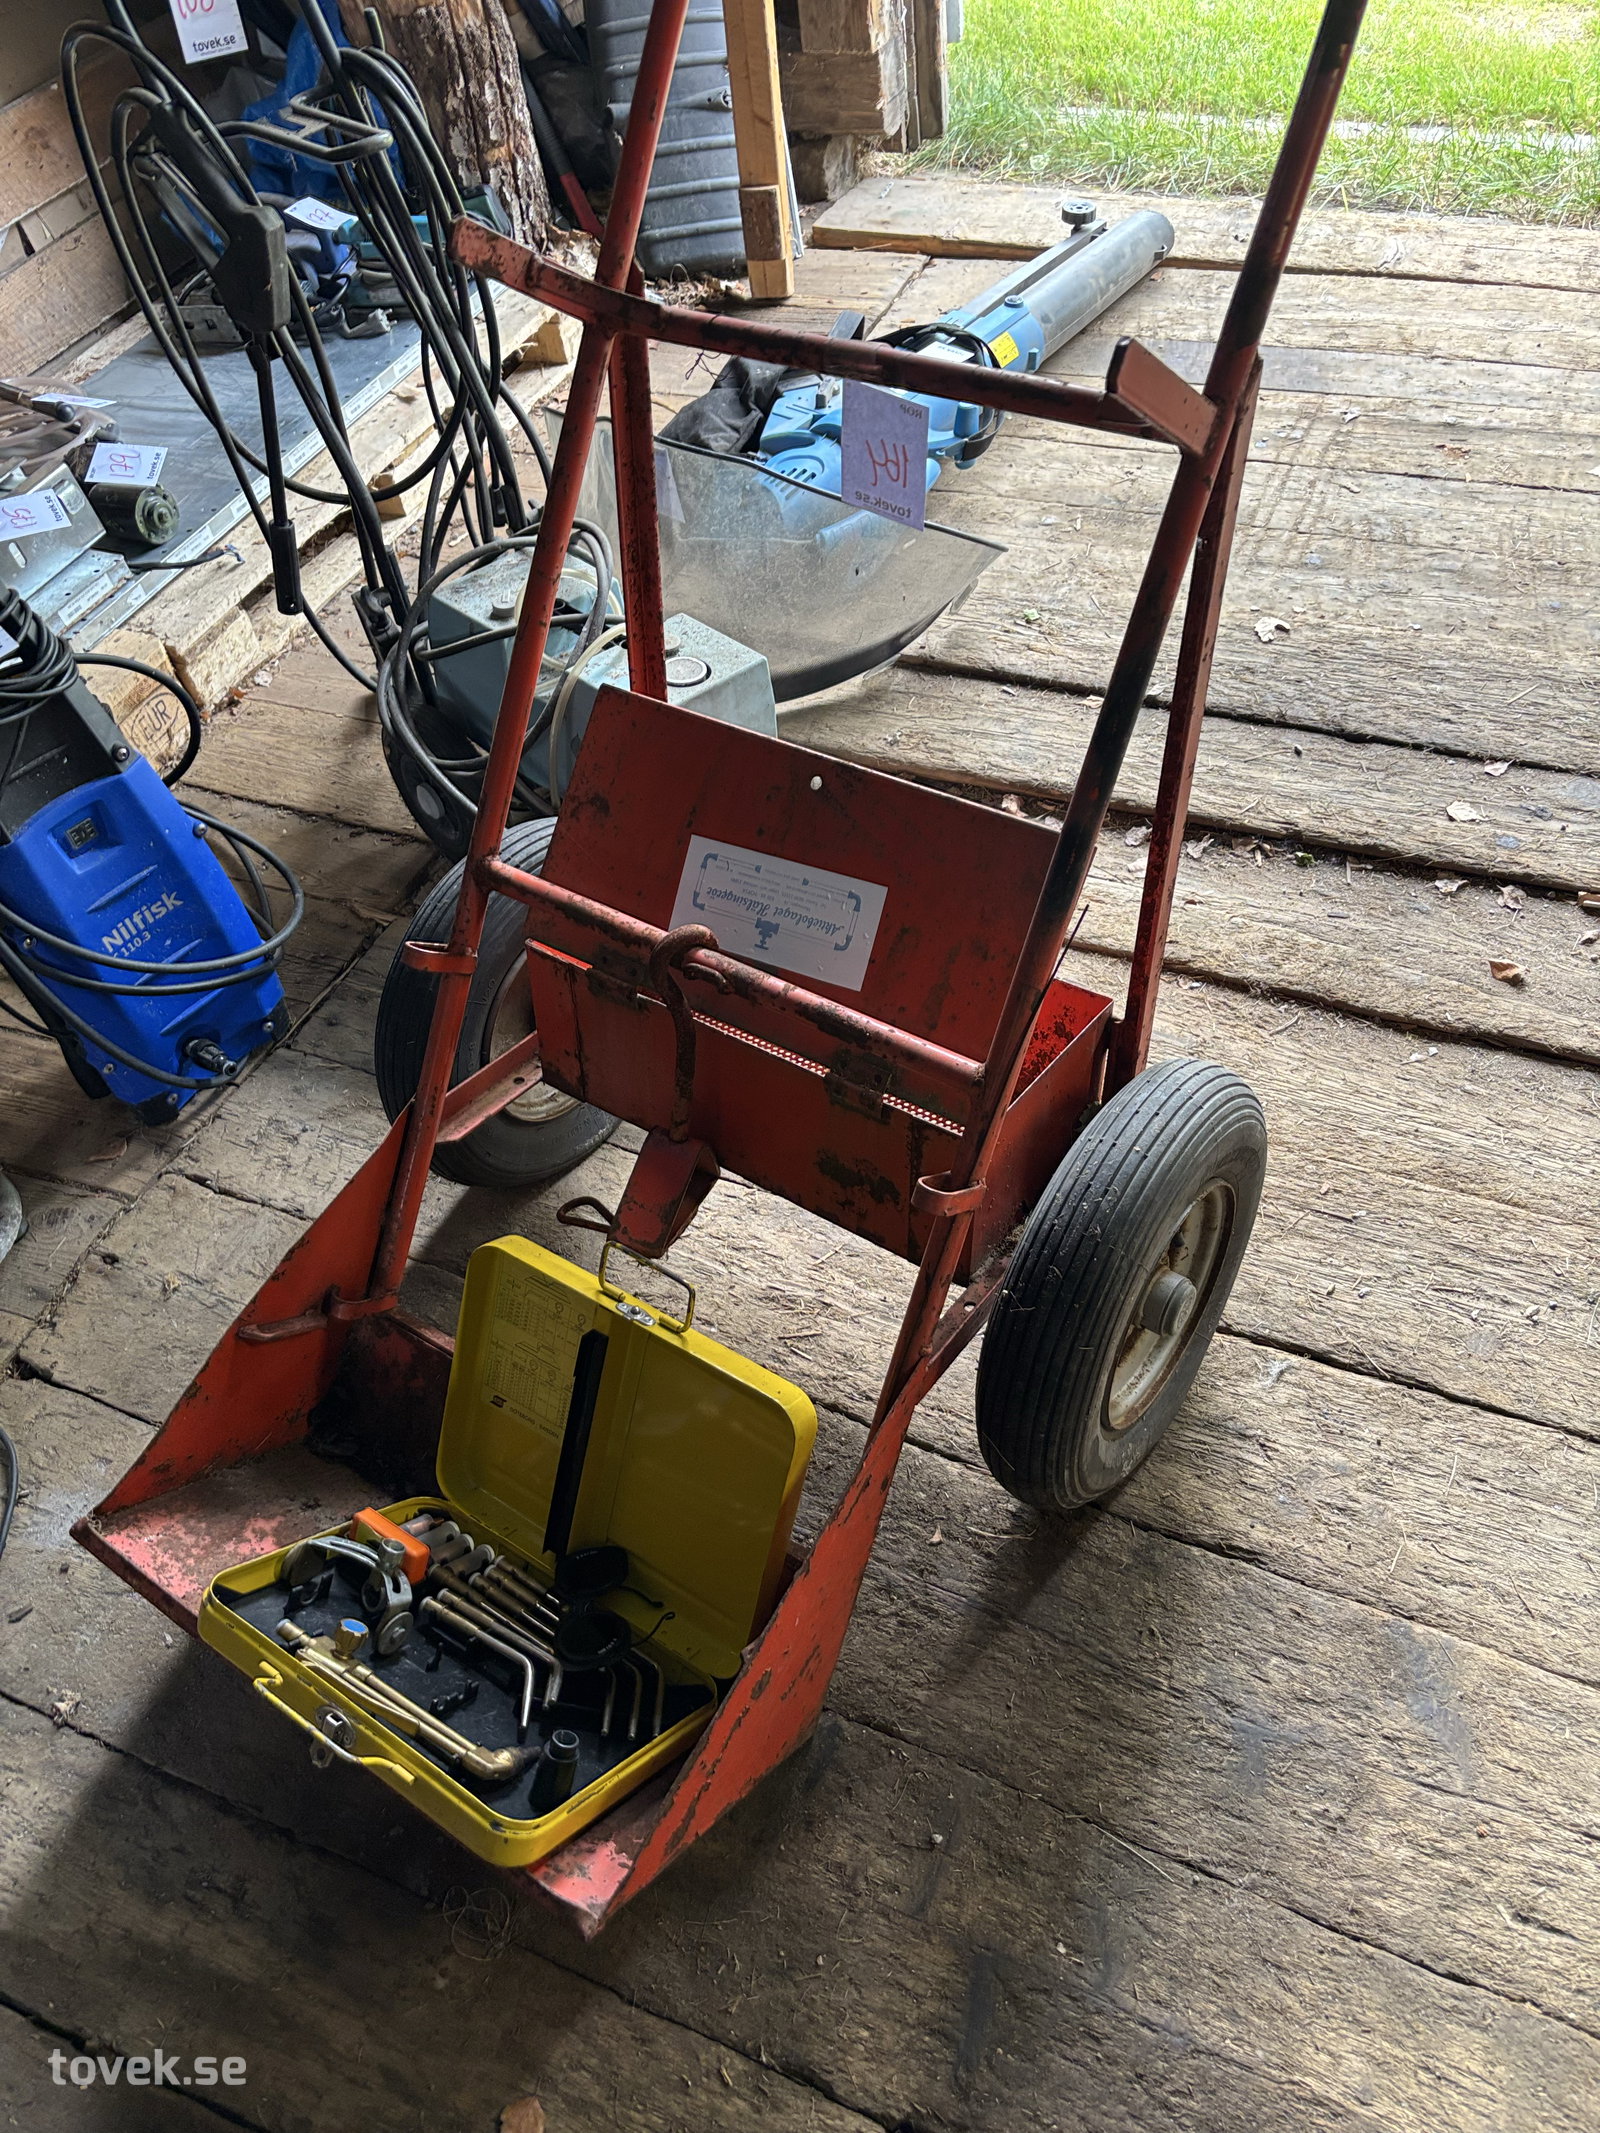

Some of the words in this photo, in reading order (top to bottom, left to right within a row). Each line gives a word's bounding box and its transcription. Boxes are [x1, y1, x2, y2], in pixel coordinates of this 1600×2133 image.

[193, 35, 236, 53] tovek.se
[146, 452, 162, 480] tovek.se
[44, 495, 63, 522] tovek.se
[138, 700, 173, 741] EUR
[102, 891, 184, 953] Nilfisk
[773, 906, 845, 937] Aktiebolaget
[120, 930, 152, 957] 110.3
